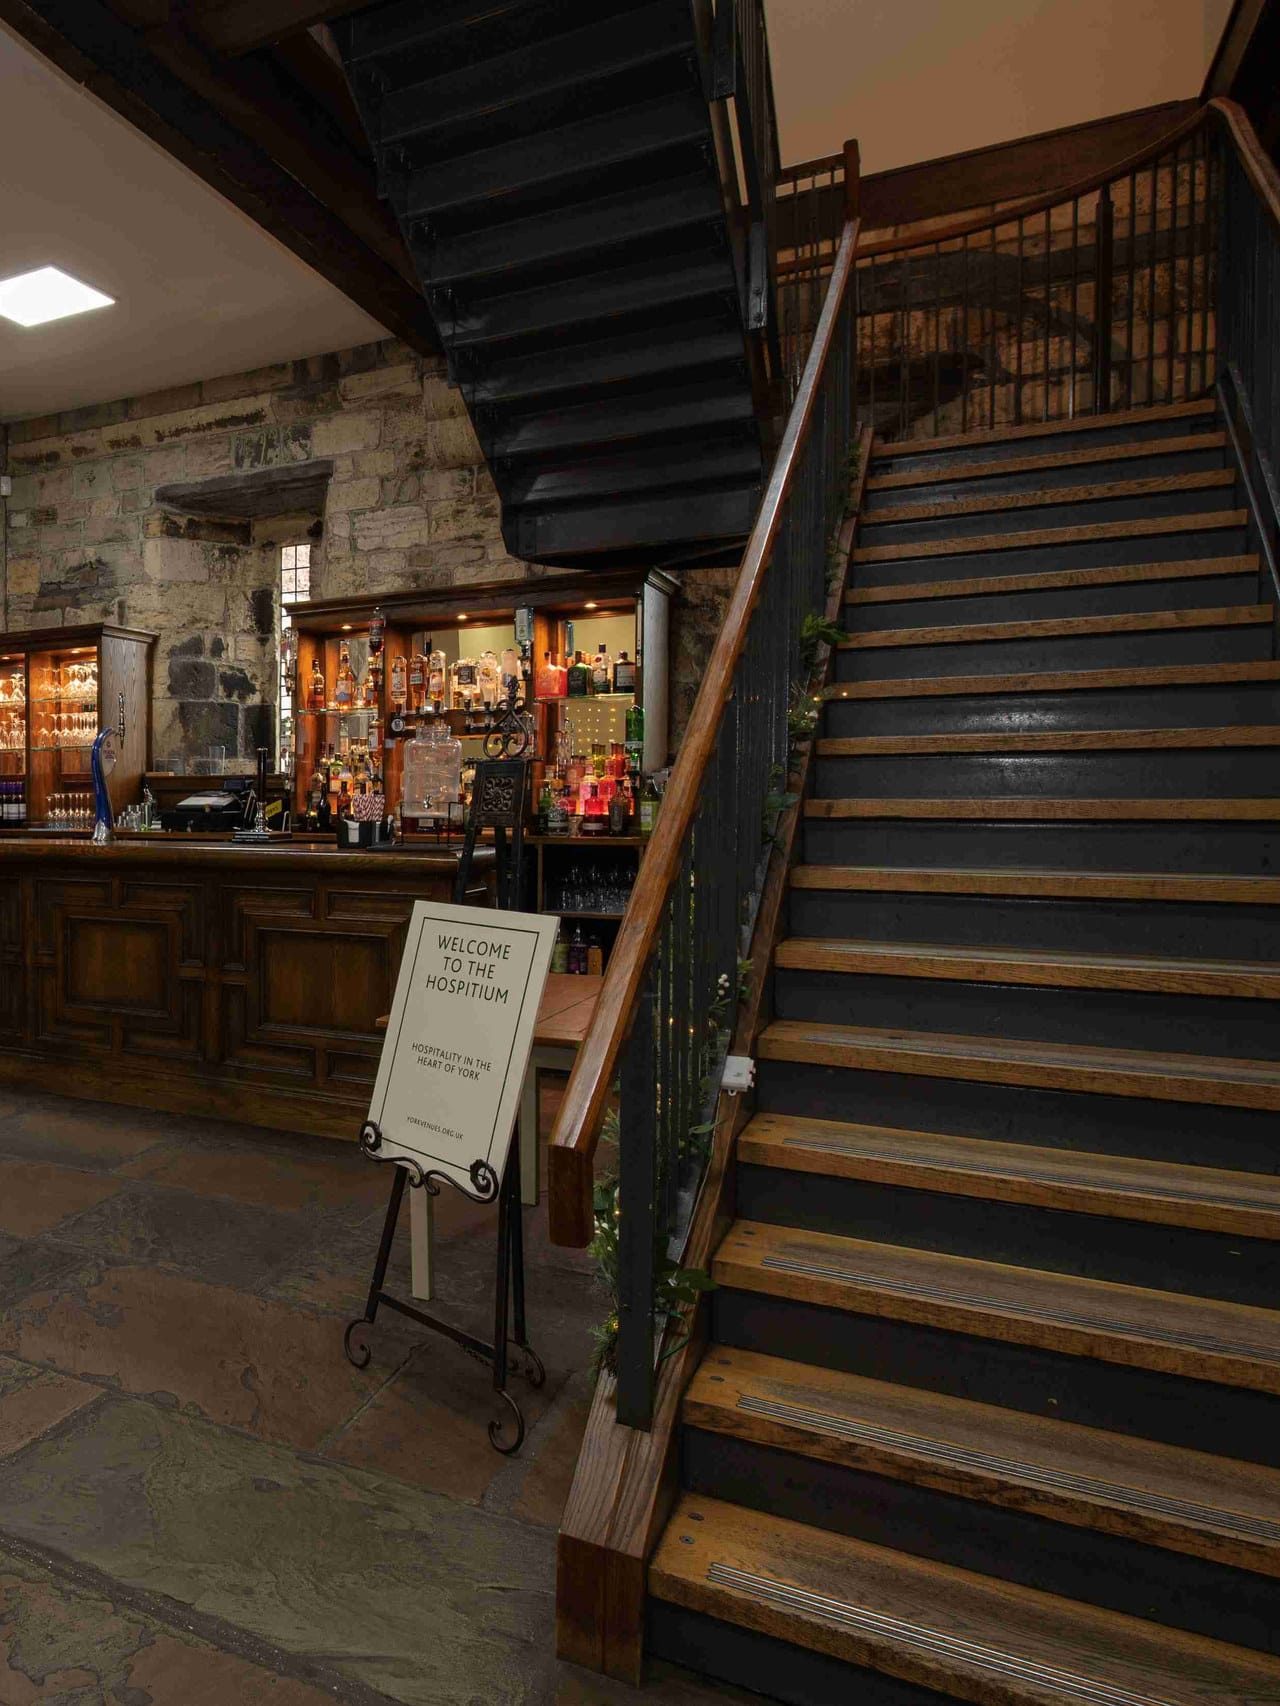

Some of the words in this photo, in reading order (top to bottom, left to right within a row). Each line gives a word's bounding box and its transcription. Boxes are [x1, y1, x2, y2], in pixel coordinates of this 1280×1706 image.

[438, 935, 511, 960] WELCOME
[443, 956, 462, 973] TO
[468, 960, 496, 979] THE
[426, 974, 509, 1004] HOSPITIUM
[411, 1042, 462, 1063] HOSPITALITY
[463, 1056, 474, 1066] IN
[475, 1059, 492, 1071] THE
[417, 1056, 443, 1069] HEART
[444, 1063, 456, 1073] OF
[458, 1066, 480, 1080] YORK
